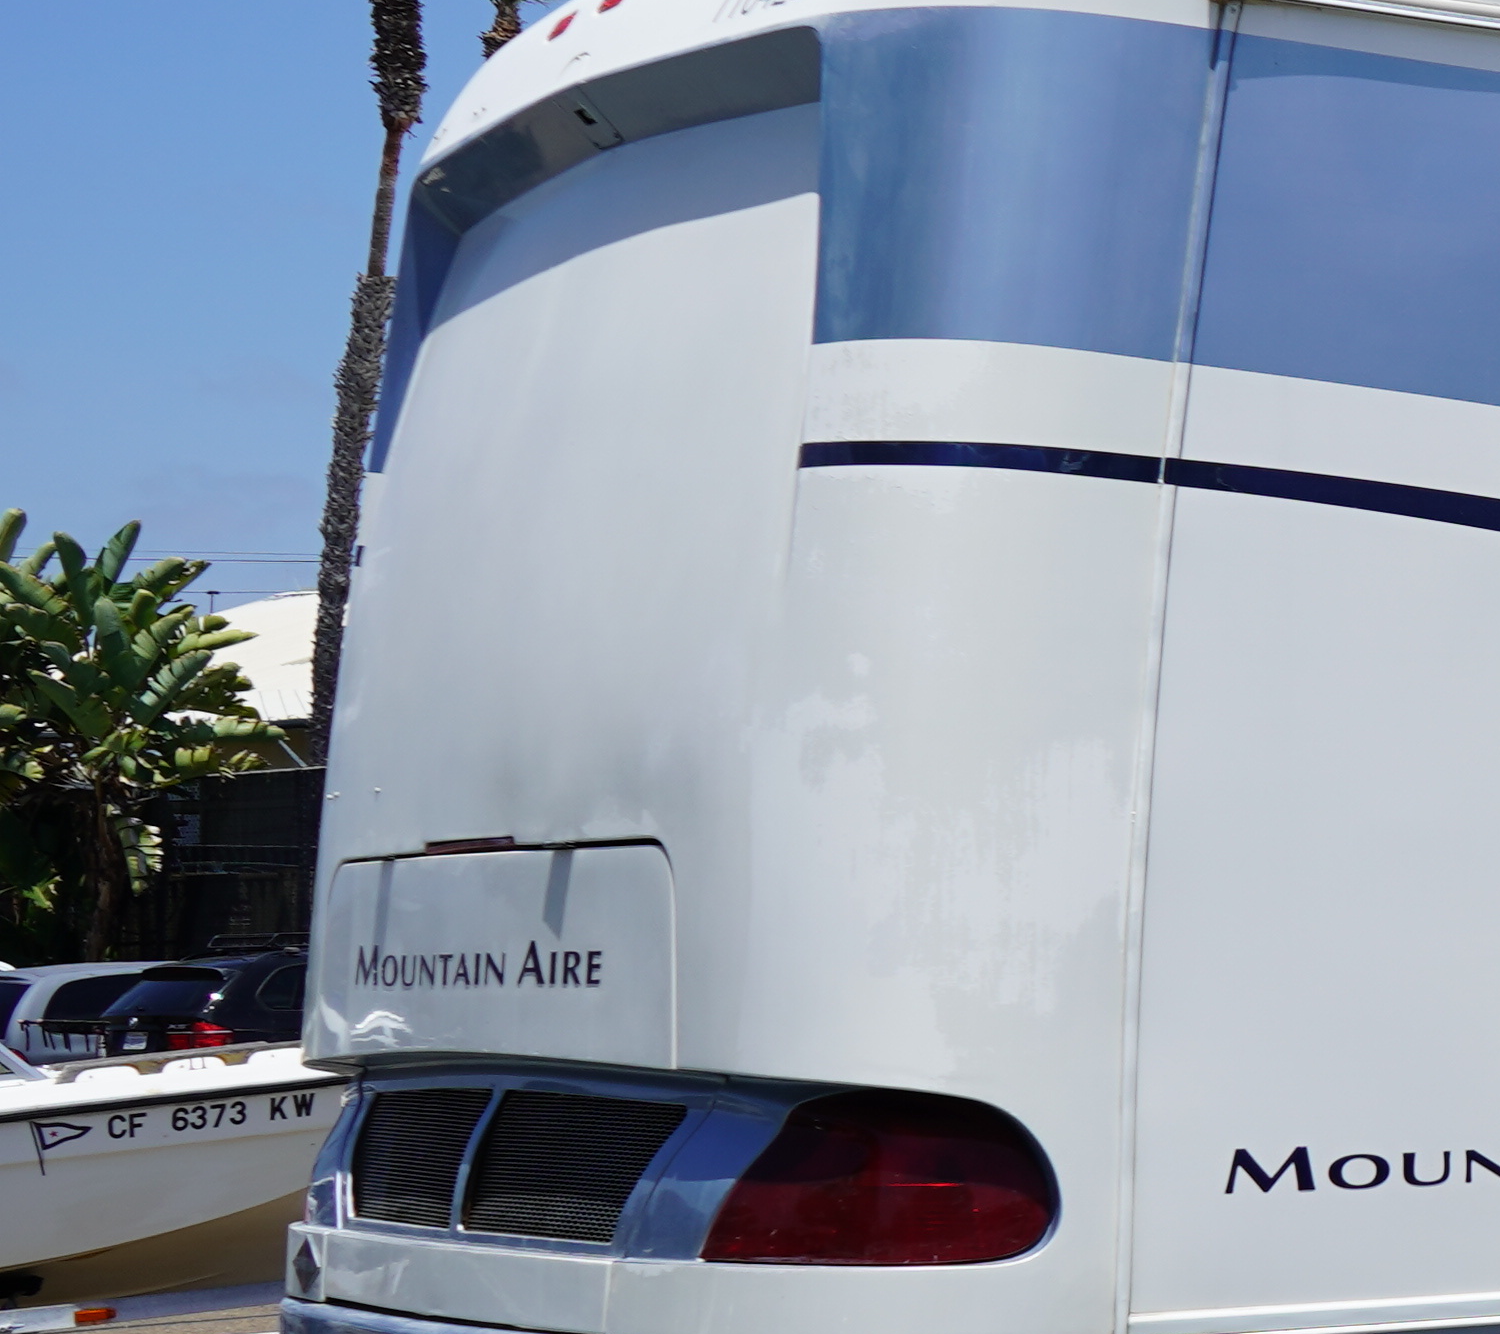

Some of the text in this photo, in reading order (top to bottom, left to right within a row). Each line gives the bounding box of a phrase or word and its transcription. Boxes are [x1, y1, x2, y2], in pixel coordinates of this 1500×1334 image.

[355, 940, 603, 988] MOUNTAIN AIRE
[107, 1093, 315, 1139] CF 6373 KW
